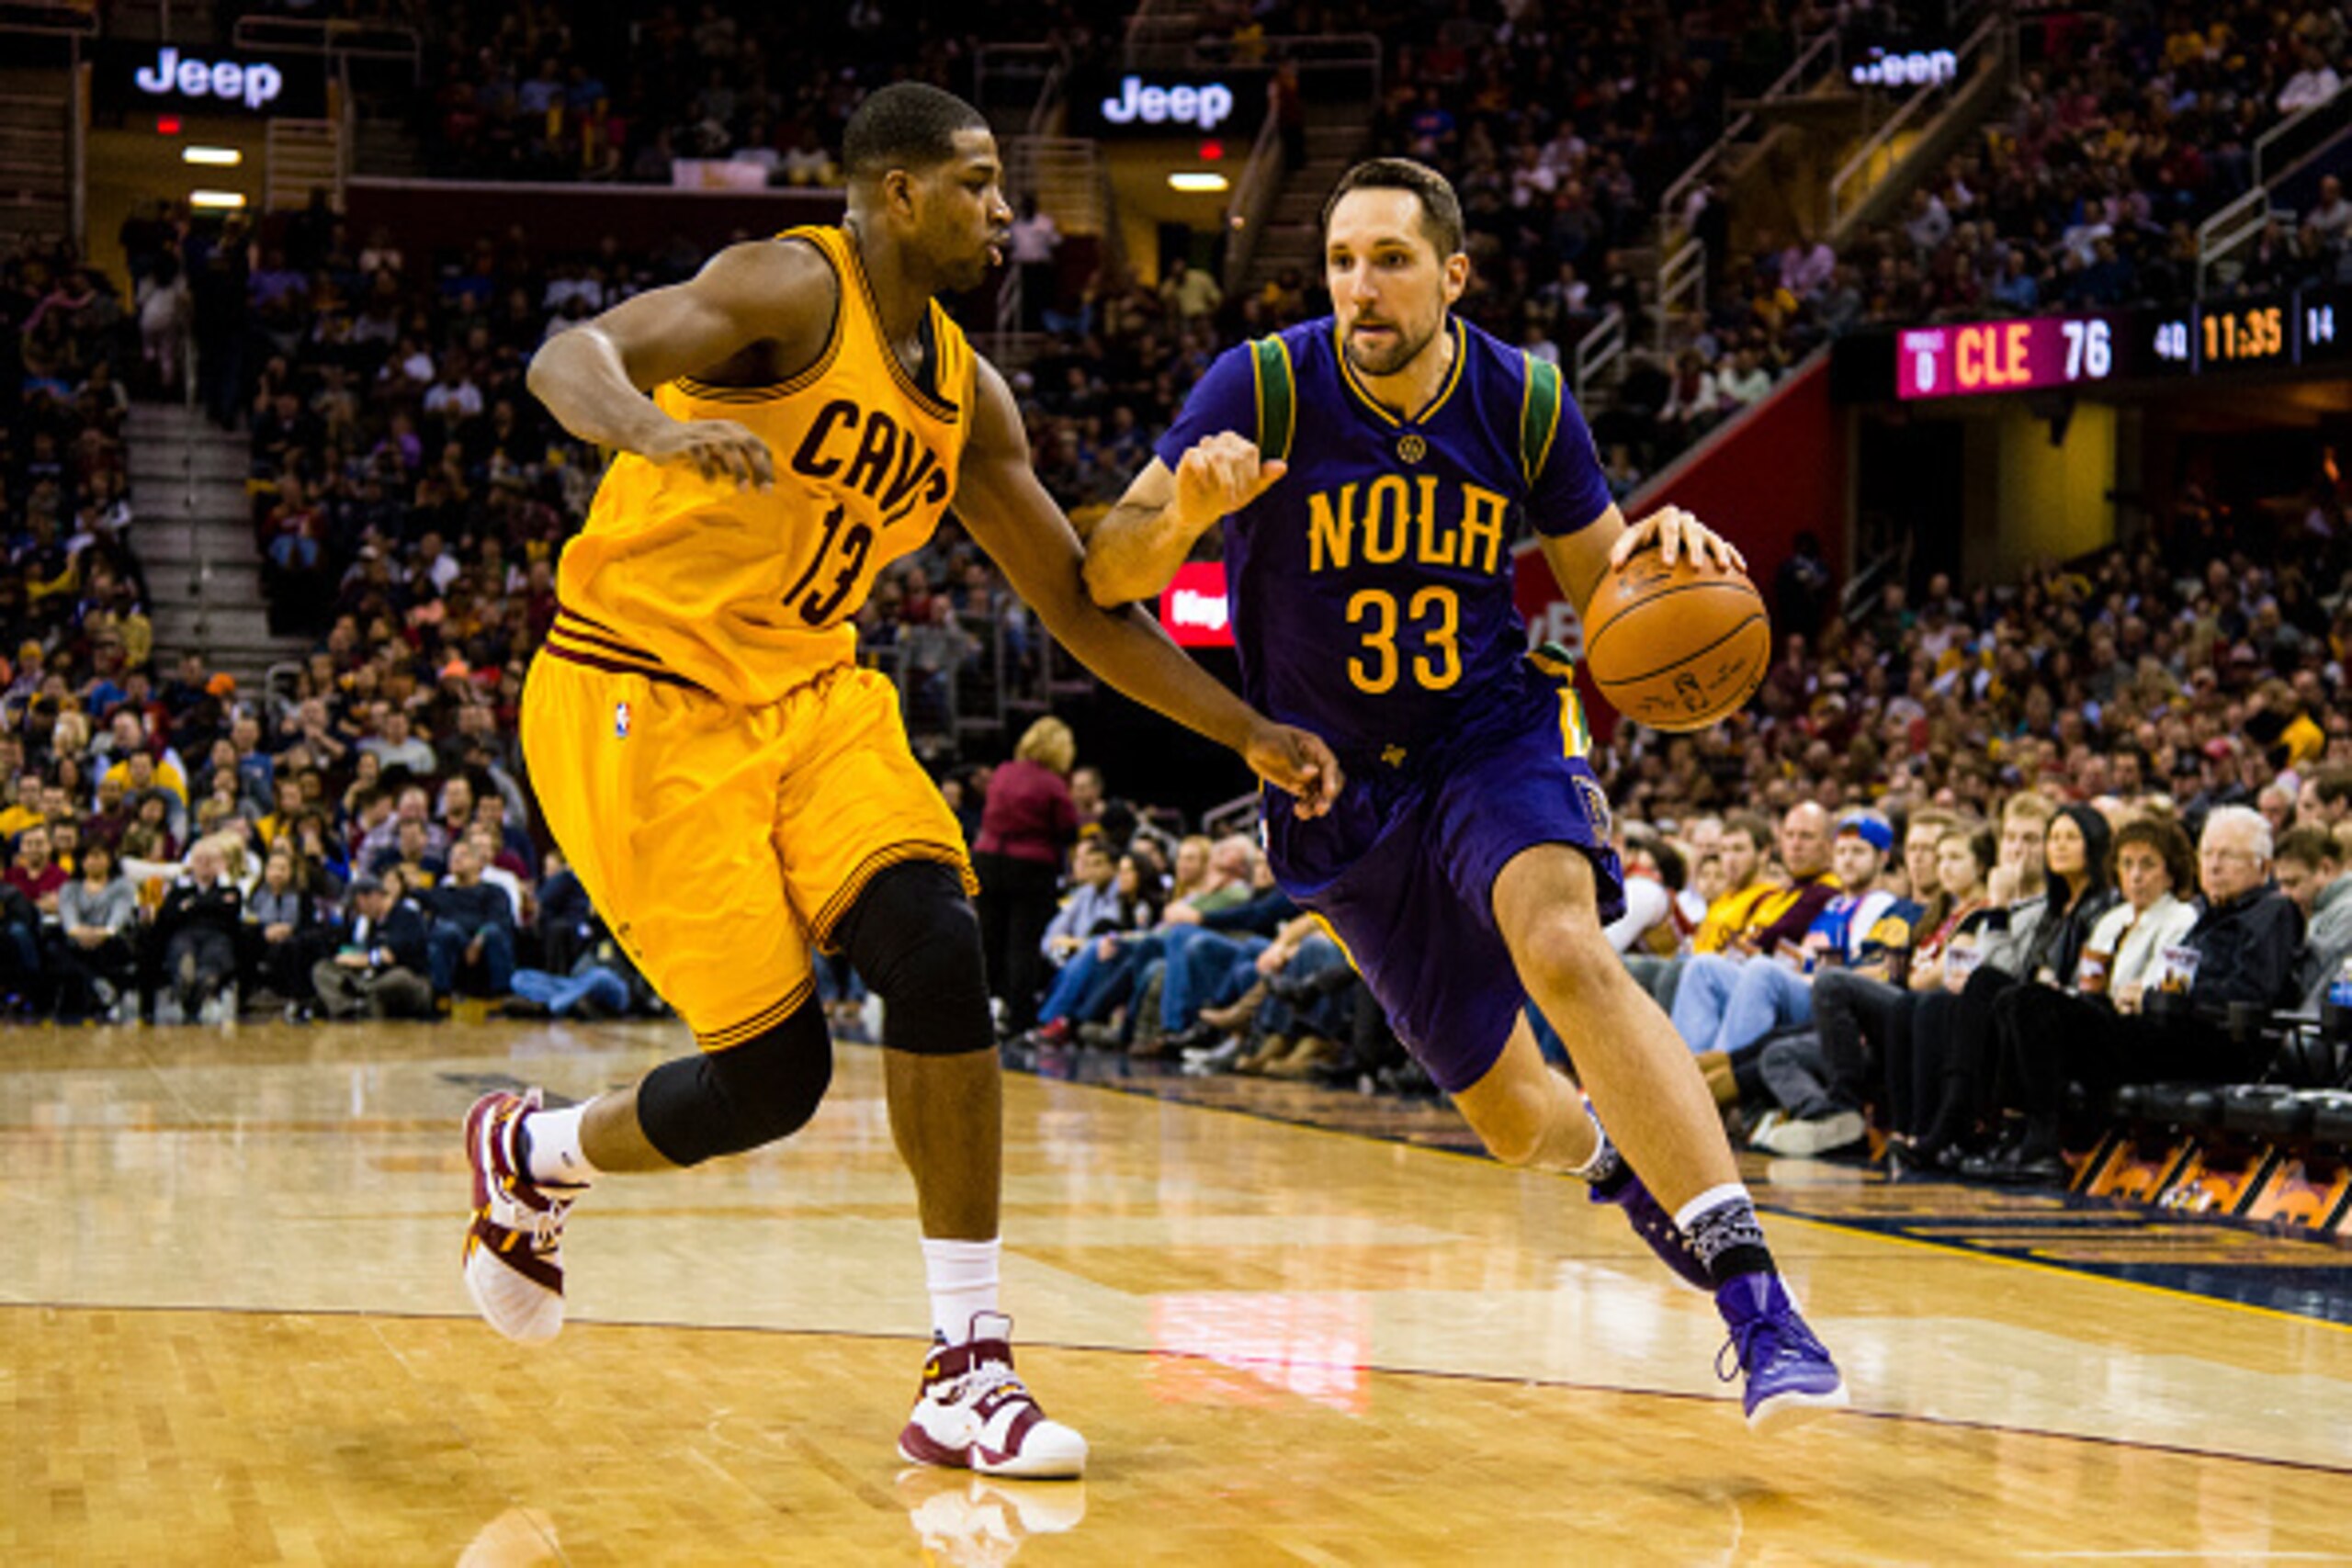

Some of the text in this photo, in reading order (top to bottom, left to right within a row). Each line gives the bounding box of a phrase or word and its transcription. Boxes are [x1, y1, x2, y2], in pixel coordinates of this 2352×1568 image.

[136, 47, 281, 109] Jeep
[1102, 75, 1232, 130] Jeep
[1956, 319, 2111, 387] CLE 76
[2204, 307, 2282, 359] 11:35
[2307, 306, 2334, 344] 14
[791, 400, 947, 527] CAVS
[782, 502, 872, 626] 13
[1306, 474, 1510, 575] NOLA
[1345, 585, 1463, 694] 33
